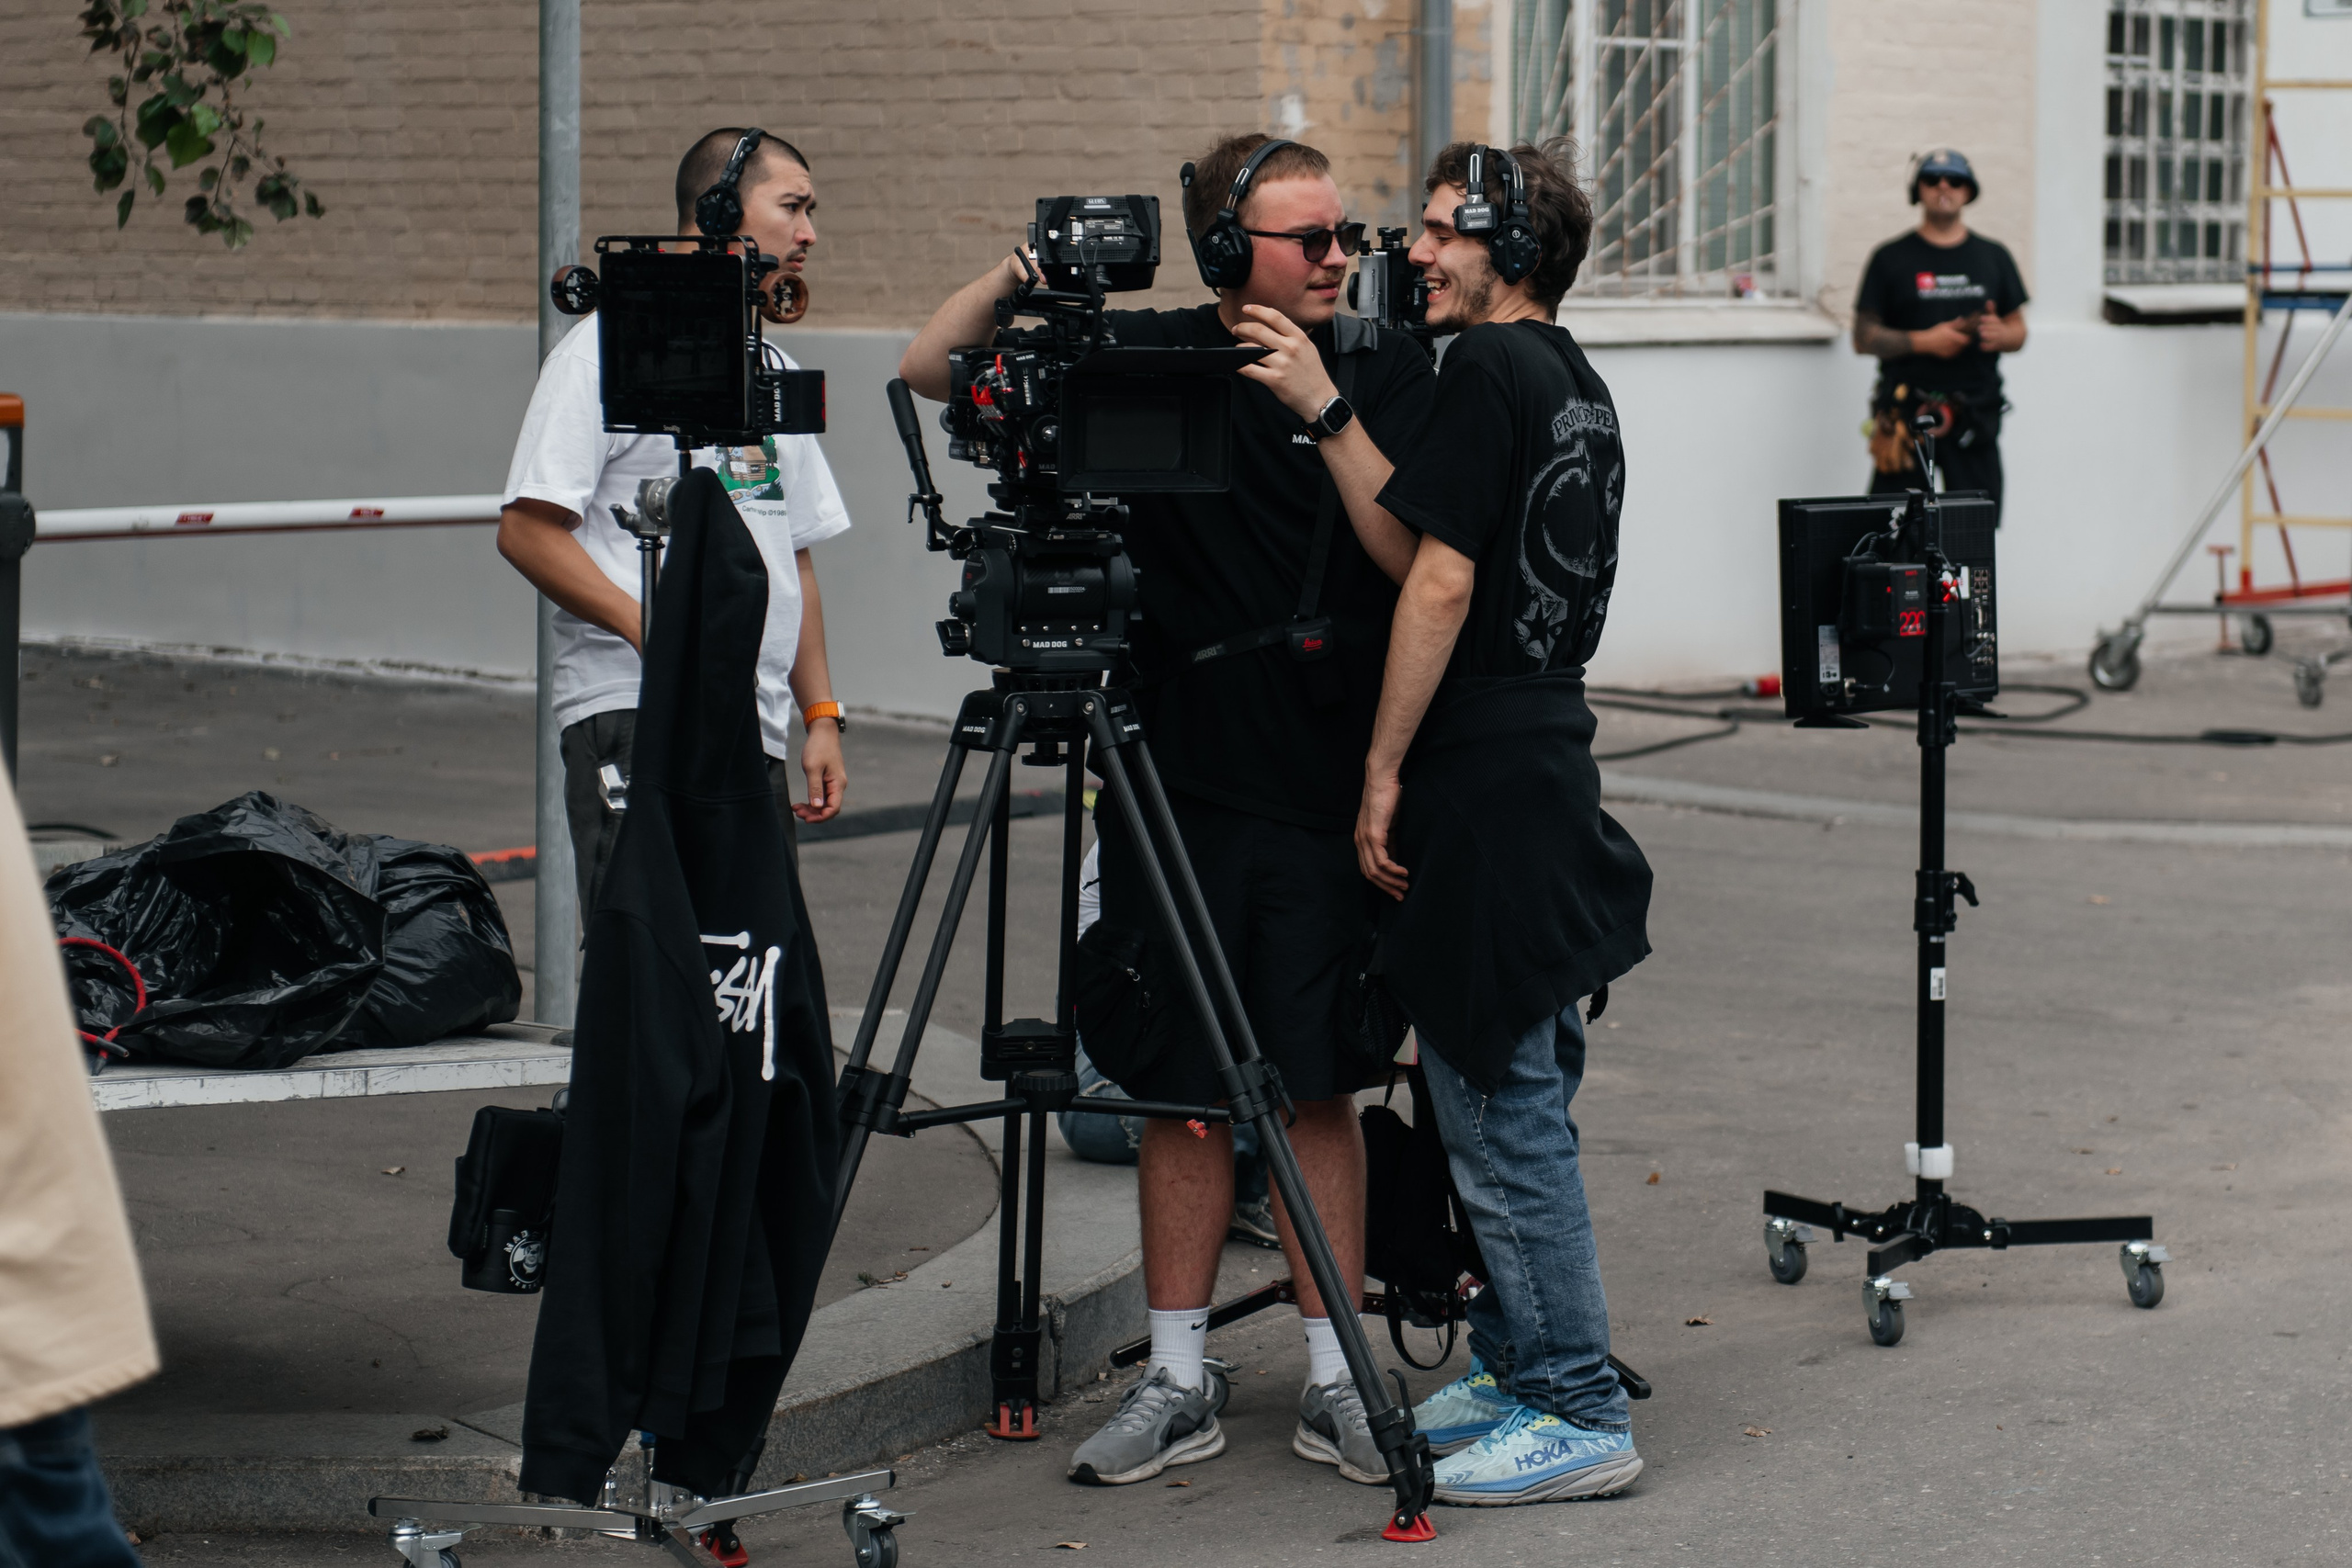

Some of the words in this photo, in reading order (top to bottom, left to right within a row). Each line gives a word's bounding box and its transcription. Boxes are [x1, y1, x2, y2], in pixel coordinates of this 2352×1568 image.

[1471, 195, 1478, 204] 7
[1292, 434, 1317, 445] MA
[1066, 513, 1082, 521] ARRI
[1899, 610, 1926, 637] 220
[1194, 645, 1217, 662] ARRI
[1514, 1439, 1573, 1472] HOKA
